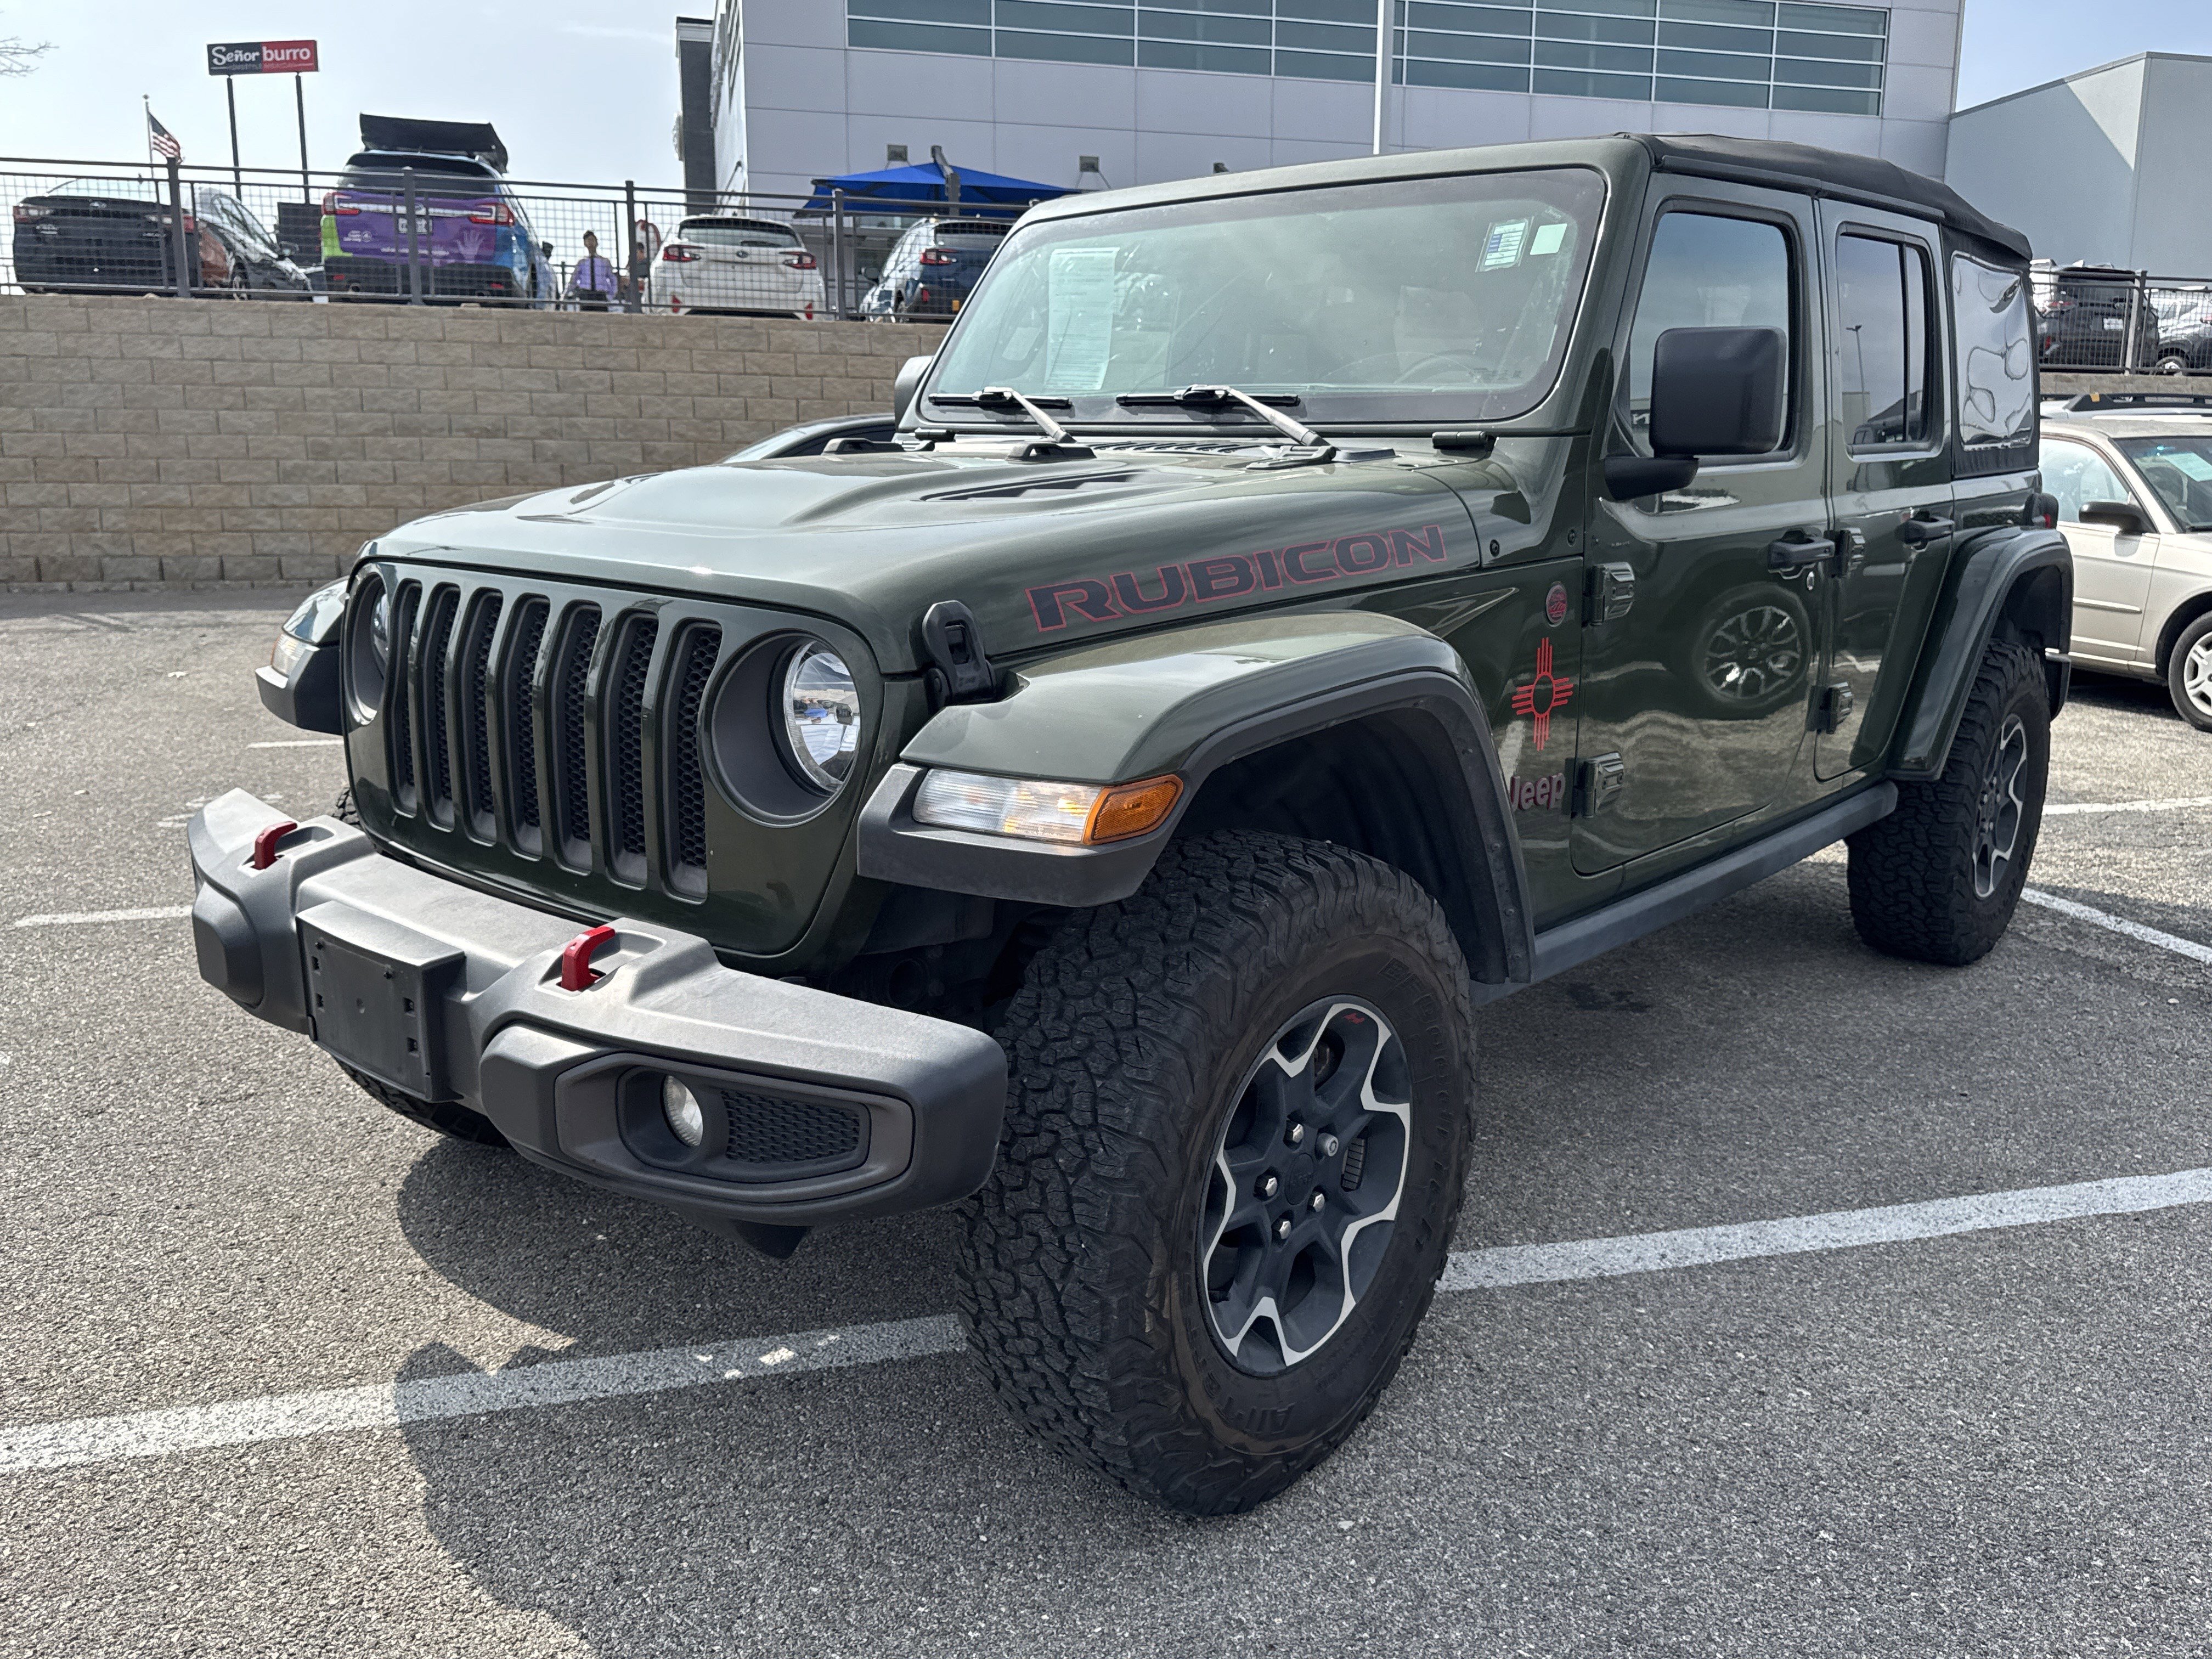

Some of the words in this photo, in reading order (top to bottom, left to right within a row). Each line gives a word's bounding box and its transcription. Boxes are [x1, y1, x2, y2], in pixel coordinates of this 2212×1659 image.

[212, 46, 259, 65] Señor
[262, 46, 311, 61] burro
[1025, 525, 1447, 633] RUBICON
[1511, 772, 1565, 811] Jeep
